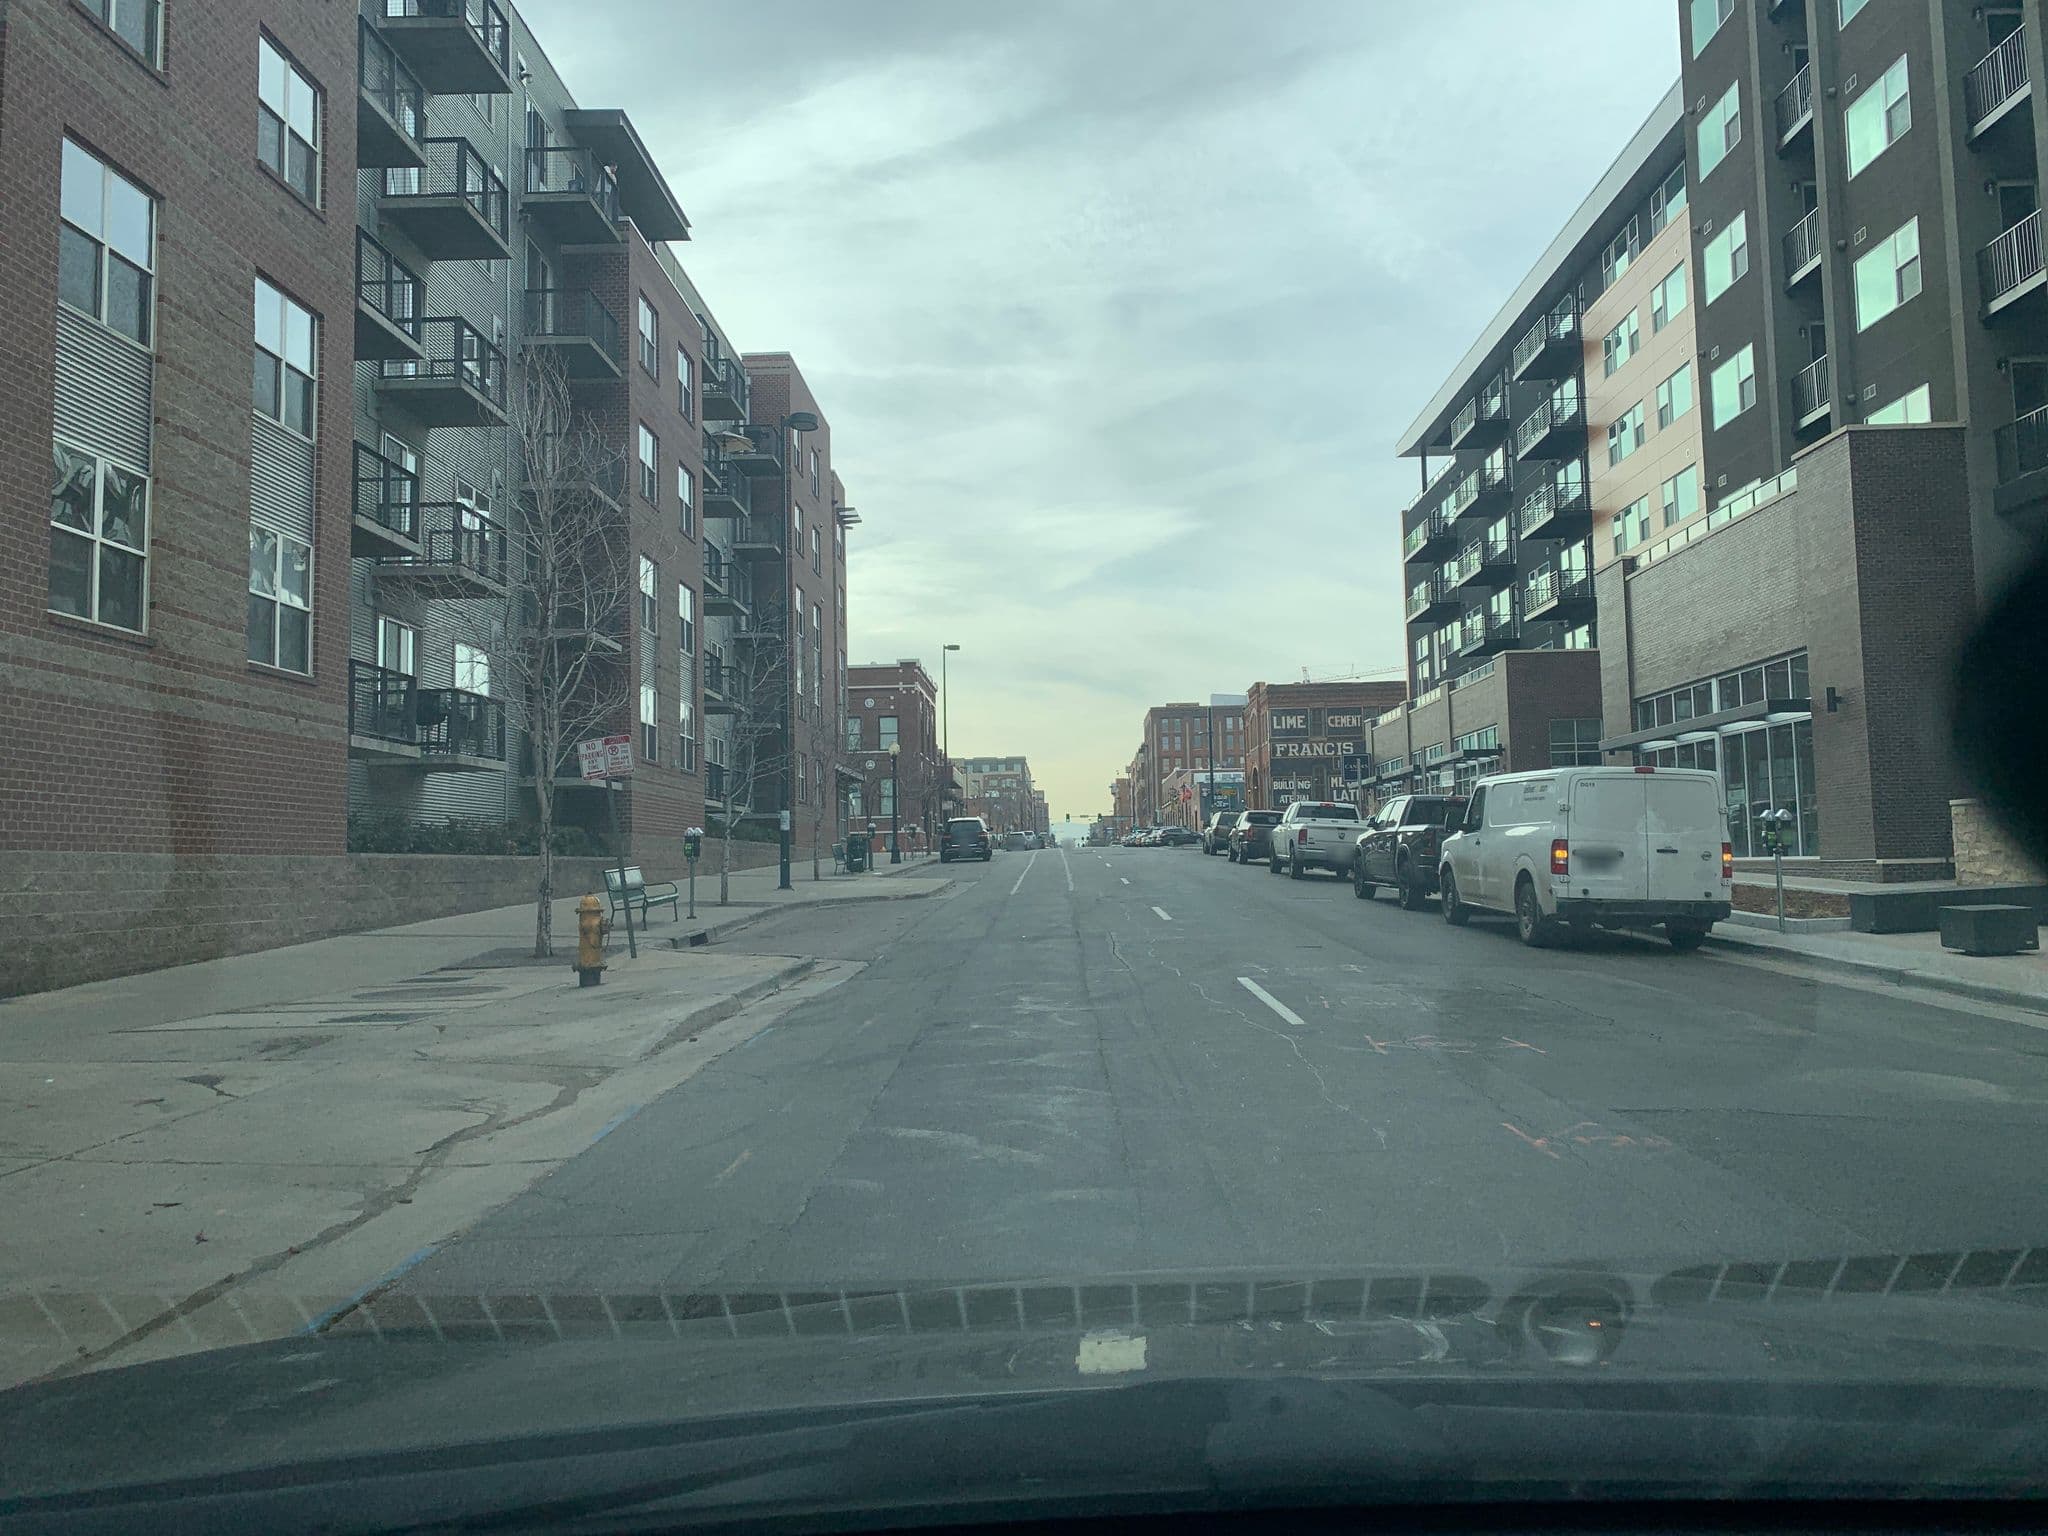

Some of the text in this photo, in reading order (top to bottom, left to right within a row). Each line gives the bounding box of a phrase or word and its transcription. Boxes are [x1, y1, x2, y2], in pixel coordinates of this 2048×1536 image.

[1273, 715, 1307, 729] LIME
[1327, 714, 1362, 728] CEMENT
[585, 742, 596, 751] NO
[1275, 742, 1355, 757] FRANCIS
[1273, 780, 1311, 790] BUILDNG
